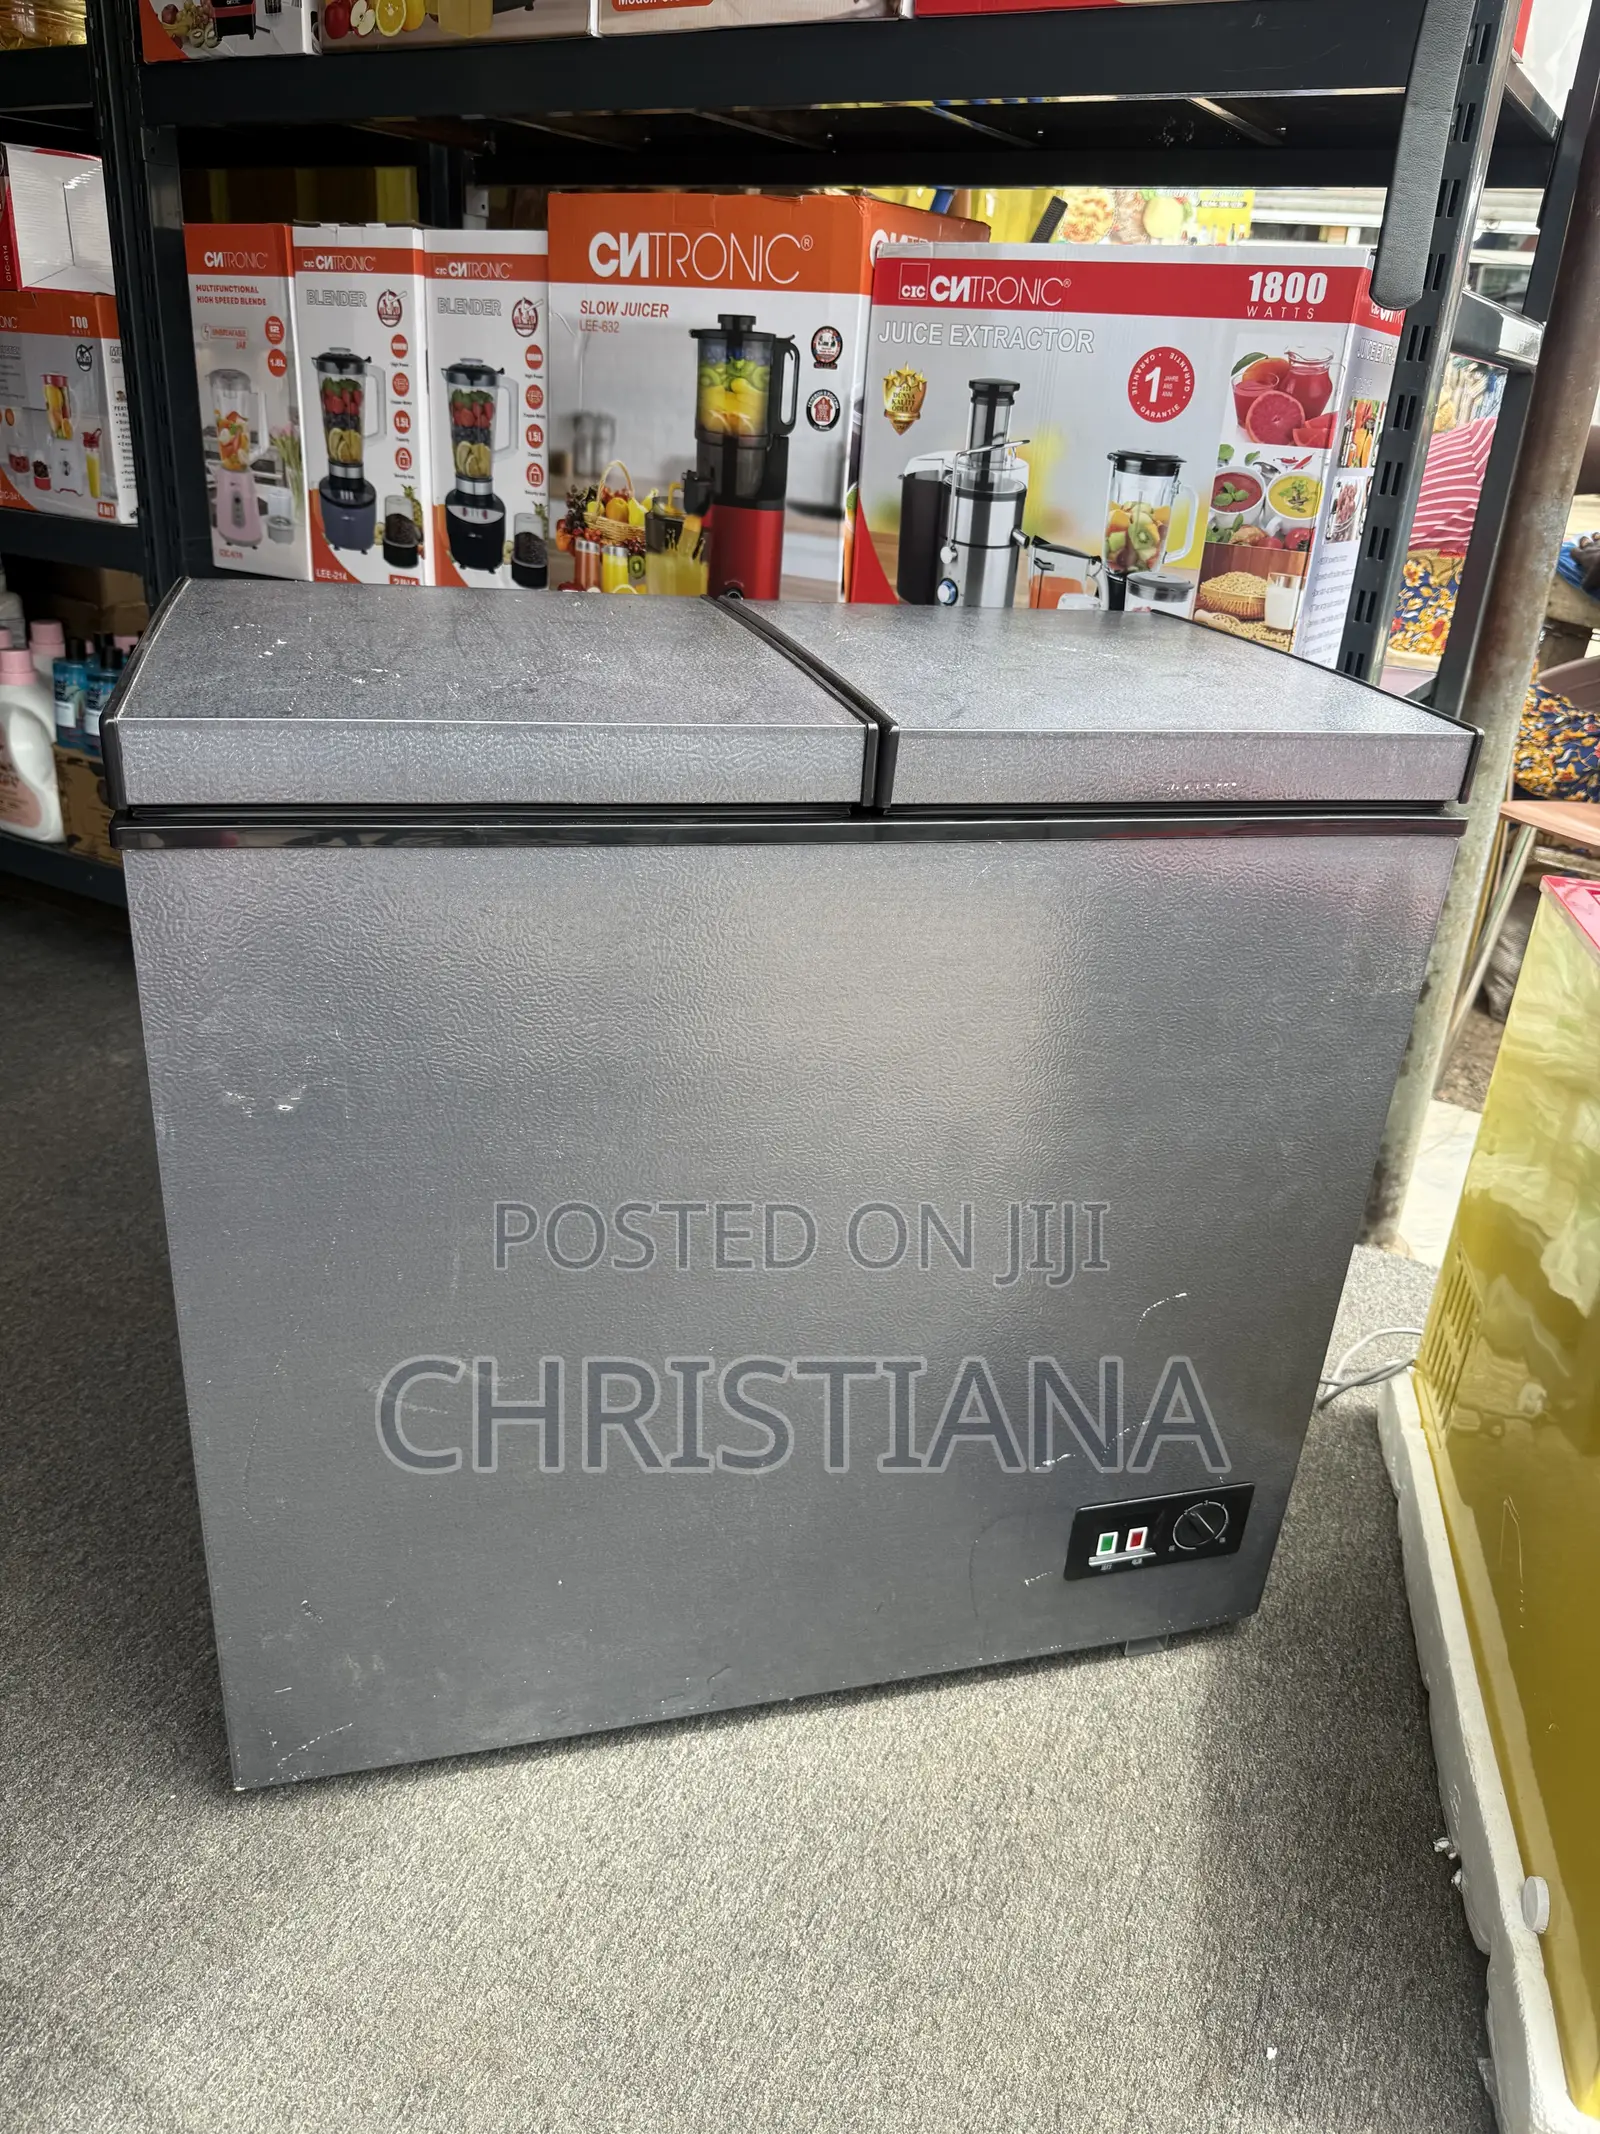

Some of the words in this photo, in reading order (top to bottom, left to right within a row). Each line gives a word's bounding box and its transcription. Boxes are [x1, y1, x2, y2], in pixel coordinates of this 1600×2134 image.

[196, 284, 259, 294] MULTIFUNCTIONAL
[901, 283, 926, 299] CIC
[1248, 271, 1328, 305] 1800
[196, 296, 214, 304] HIGH
[306, 289, 368, 308] BLENDER
[437, 297, 502, 317] BLENDER
[580, 300, 619, 316] SLOW
[620, 302, 669, 319] JUICER
[1247, 305, 1315, 320] WATTS
[70, 315, 89, 330] 700
[579, 319, 620, 334] LEE-632
[878, 320, 944, 346] JUICE
[947, 323, 1095, 354] EXTRACTOR
[1131, 353, 1156, 396] GARANTIE
[1168, 351, 1191, 393] GARANTIE
[1144, 366, 1162, 403] 1
[1140, 403, 1181, 419] GARANTIE
